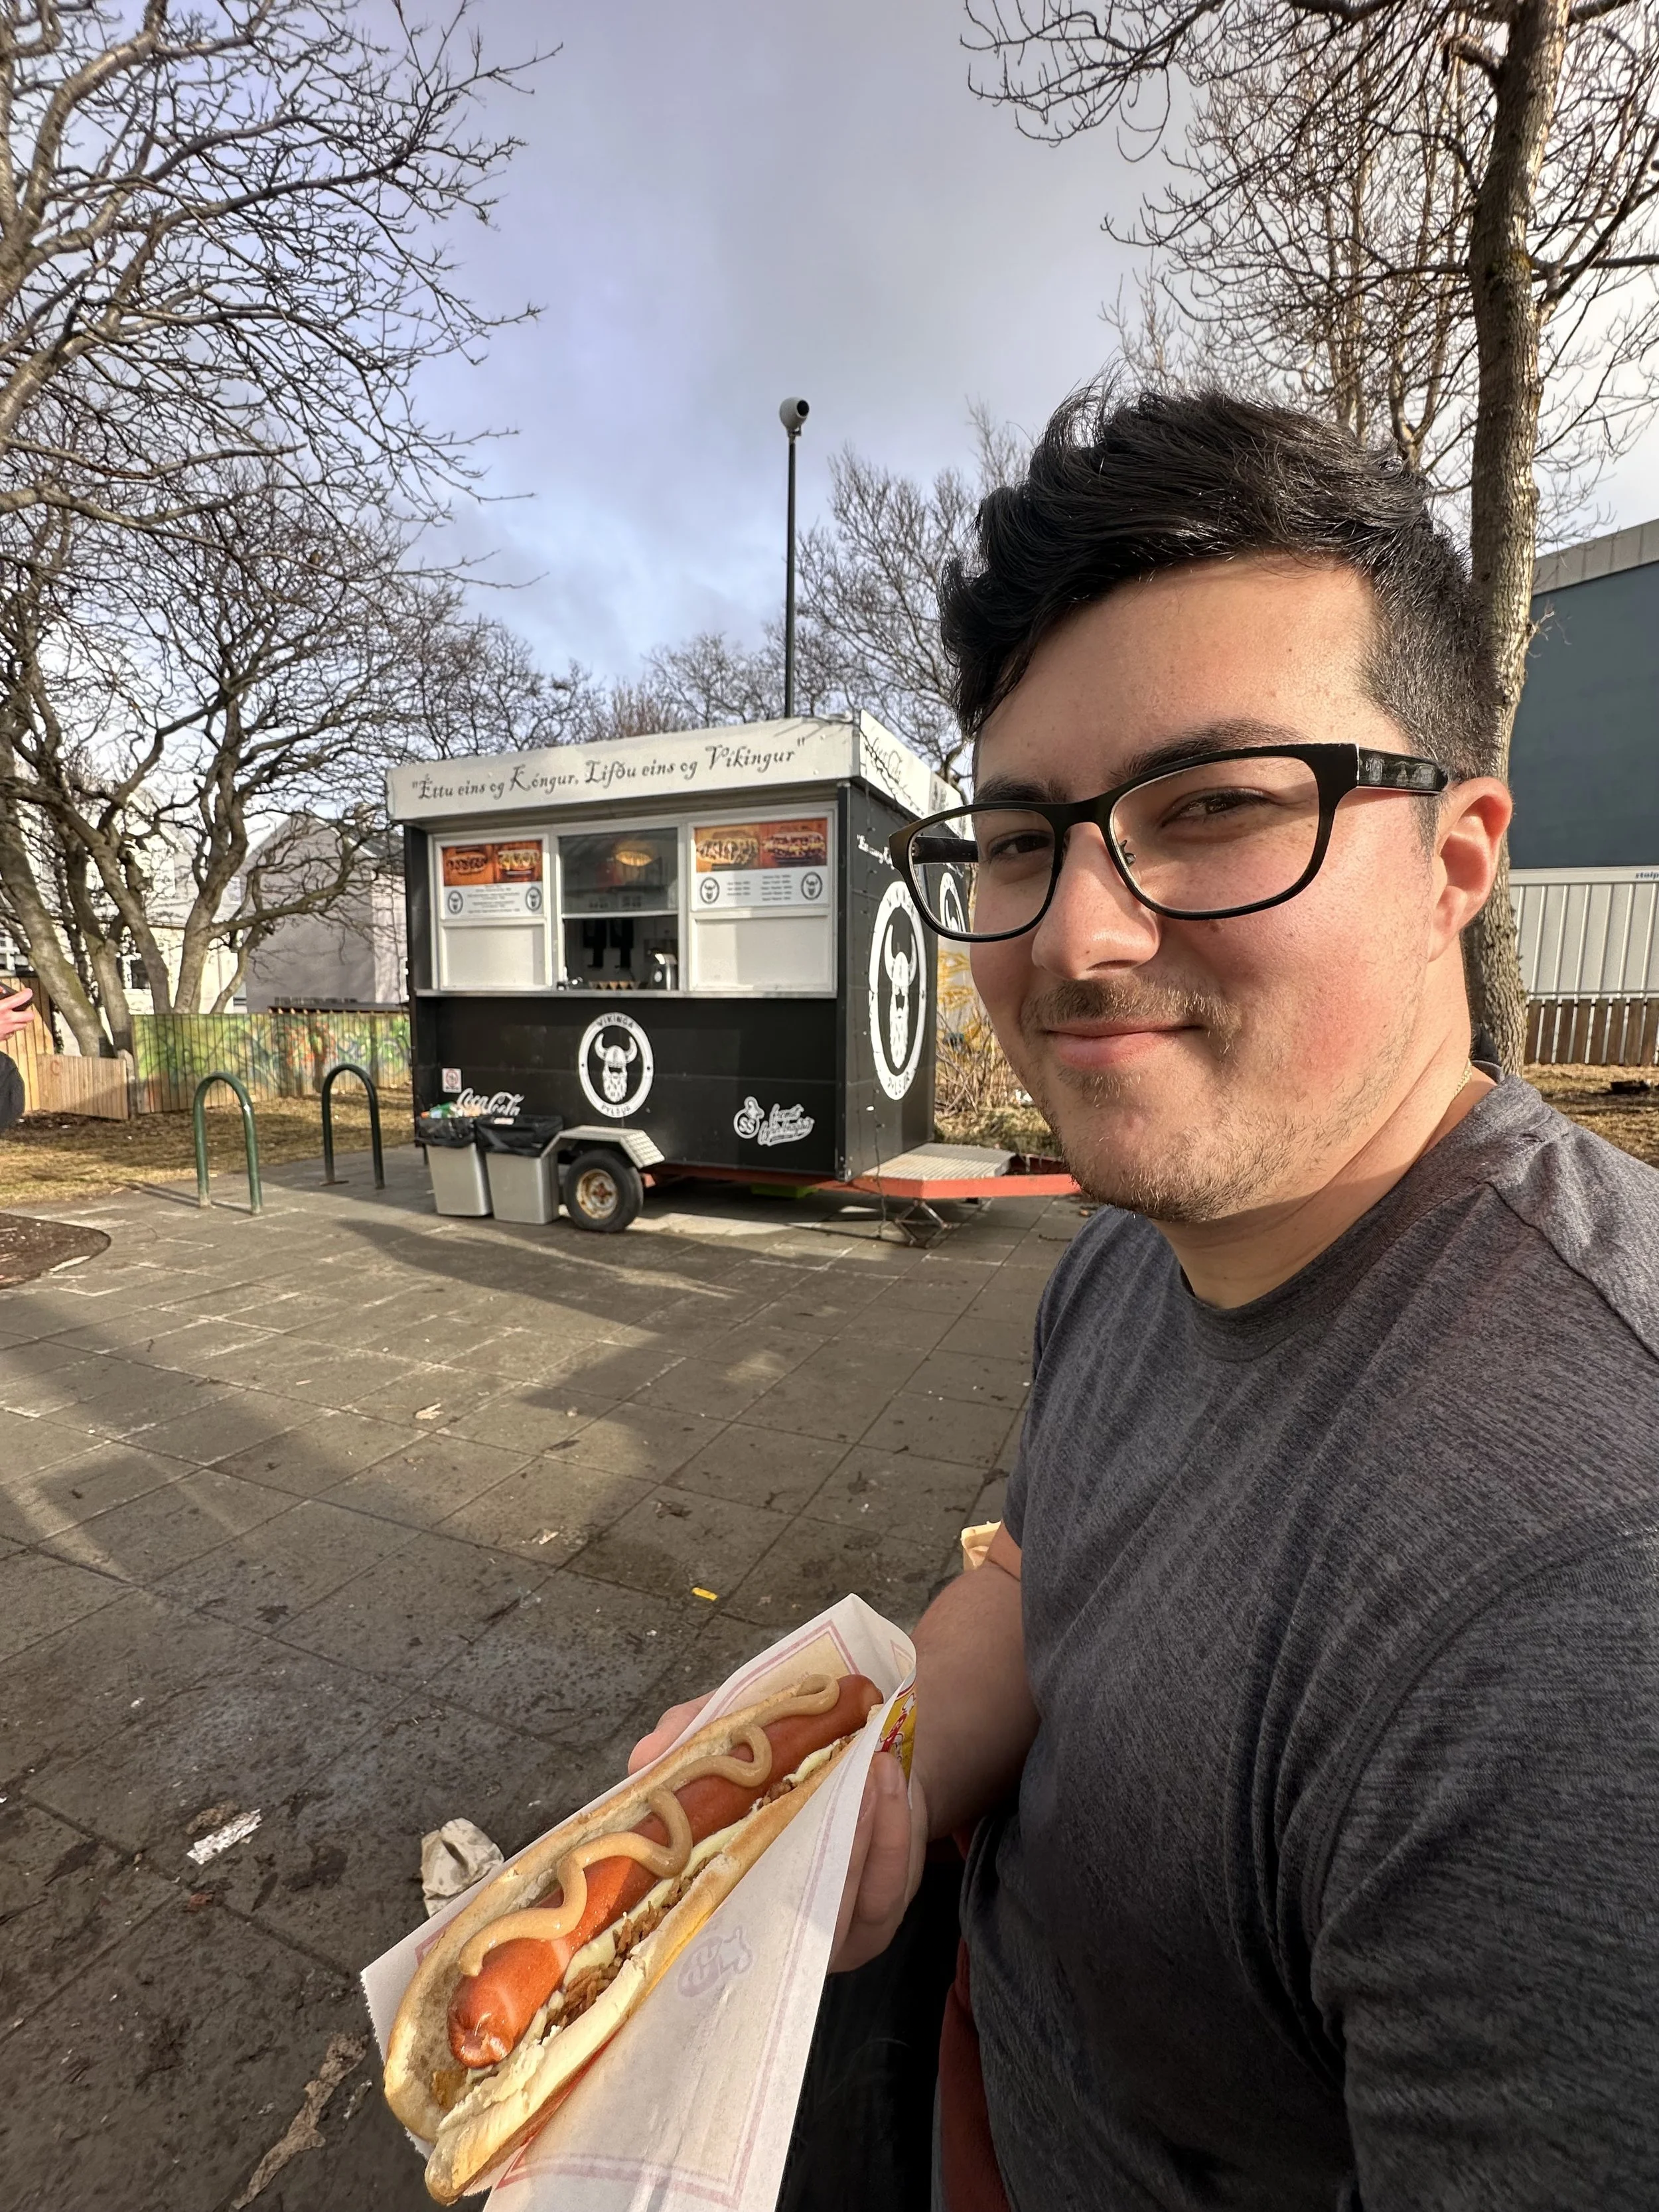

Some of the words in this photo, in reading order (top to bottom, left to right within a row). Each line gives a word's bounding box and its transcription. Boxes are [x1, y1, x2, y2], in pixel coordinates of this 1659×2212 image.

[458, 780, 486, 795] eins
[489, 782, 504, 800] og
[510, 764, 579, 794] Kóngur,
[642, 759, 674, 776] eins
[680, 761, 699, 780] og
[597, 1015, 634, 1028] VIKINGA
[739, 1116, 755, 1134] SS
